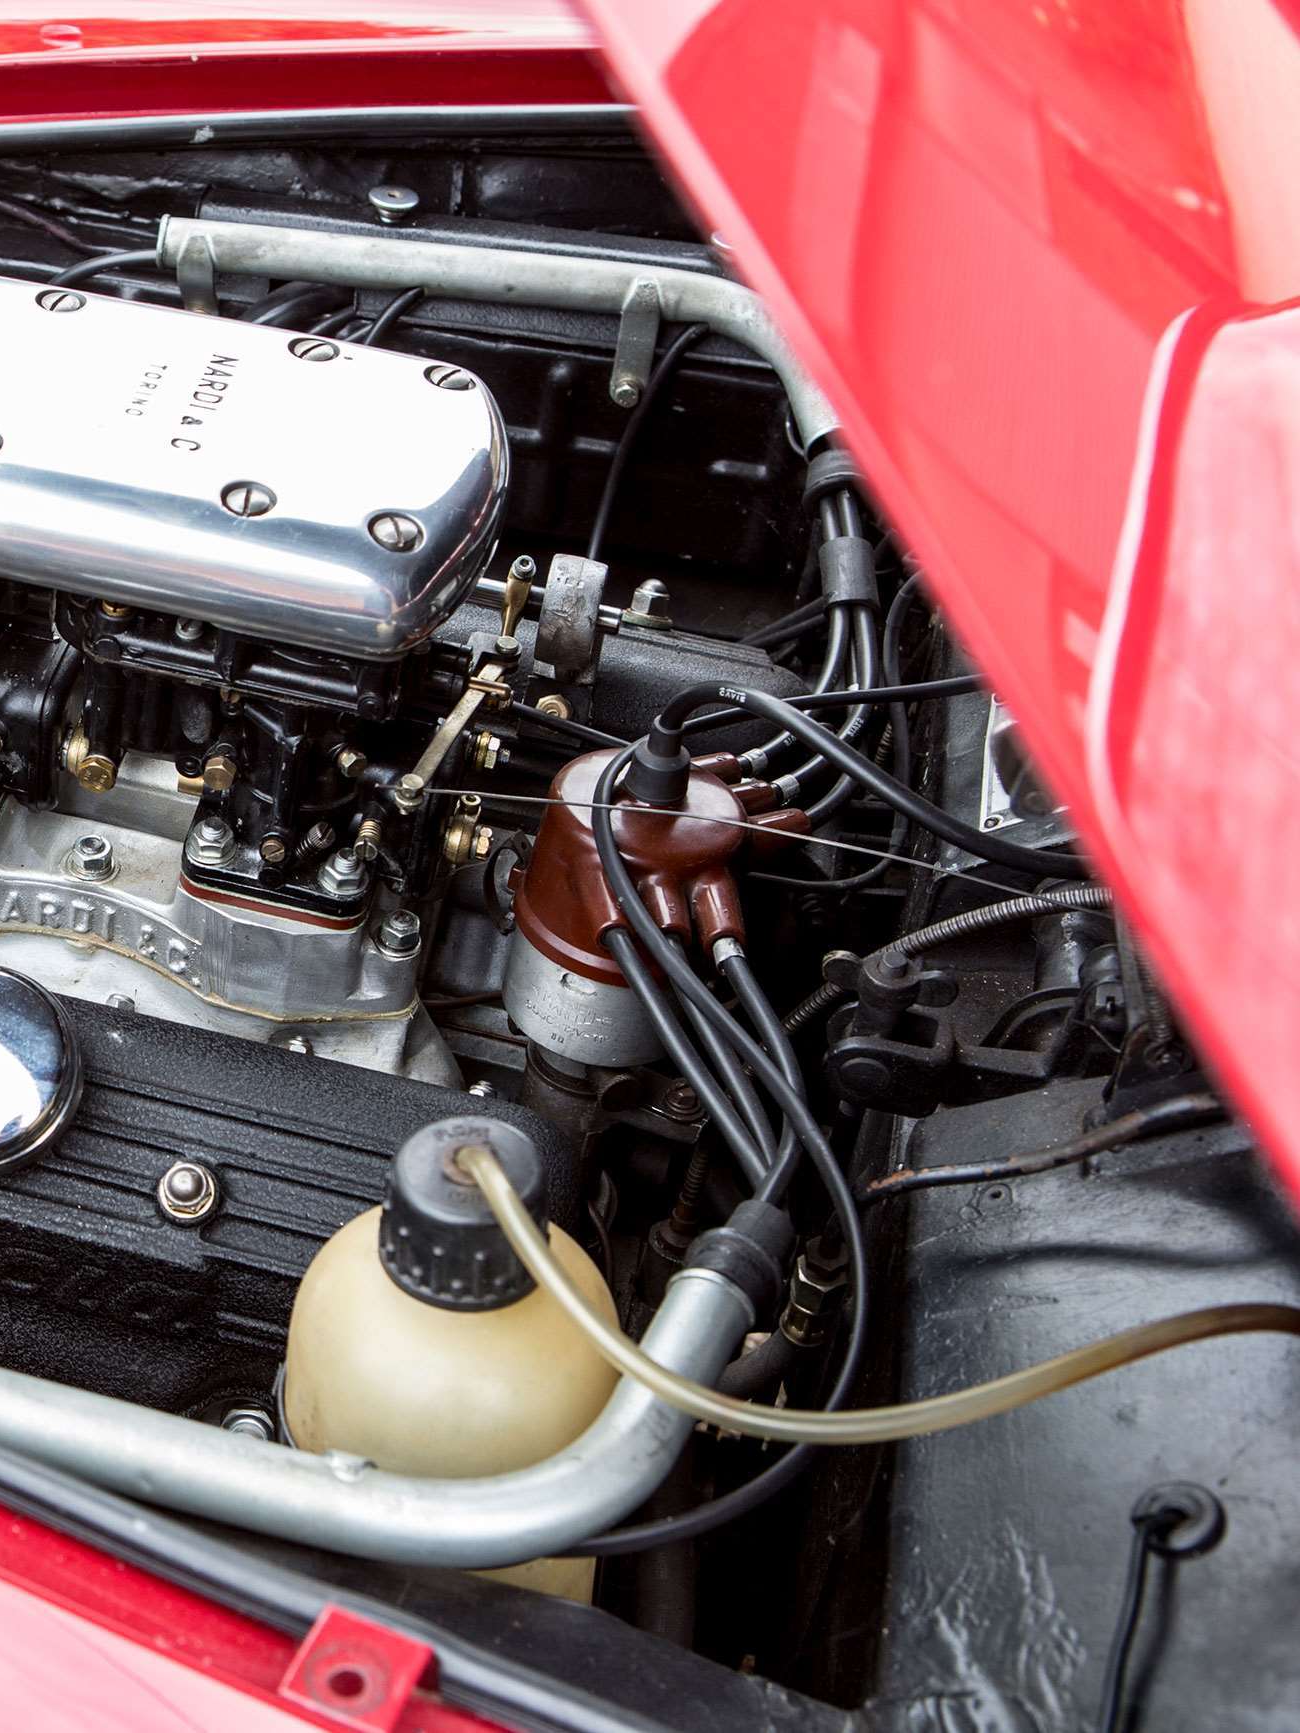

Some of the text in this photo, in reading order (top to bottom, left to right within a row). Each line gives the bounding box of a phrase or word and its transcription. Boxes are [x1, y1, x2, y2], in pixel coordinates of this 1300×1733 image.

[124, 363, 168, 416] TORINO
[170, 353, 240, 451] NARDI & C
